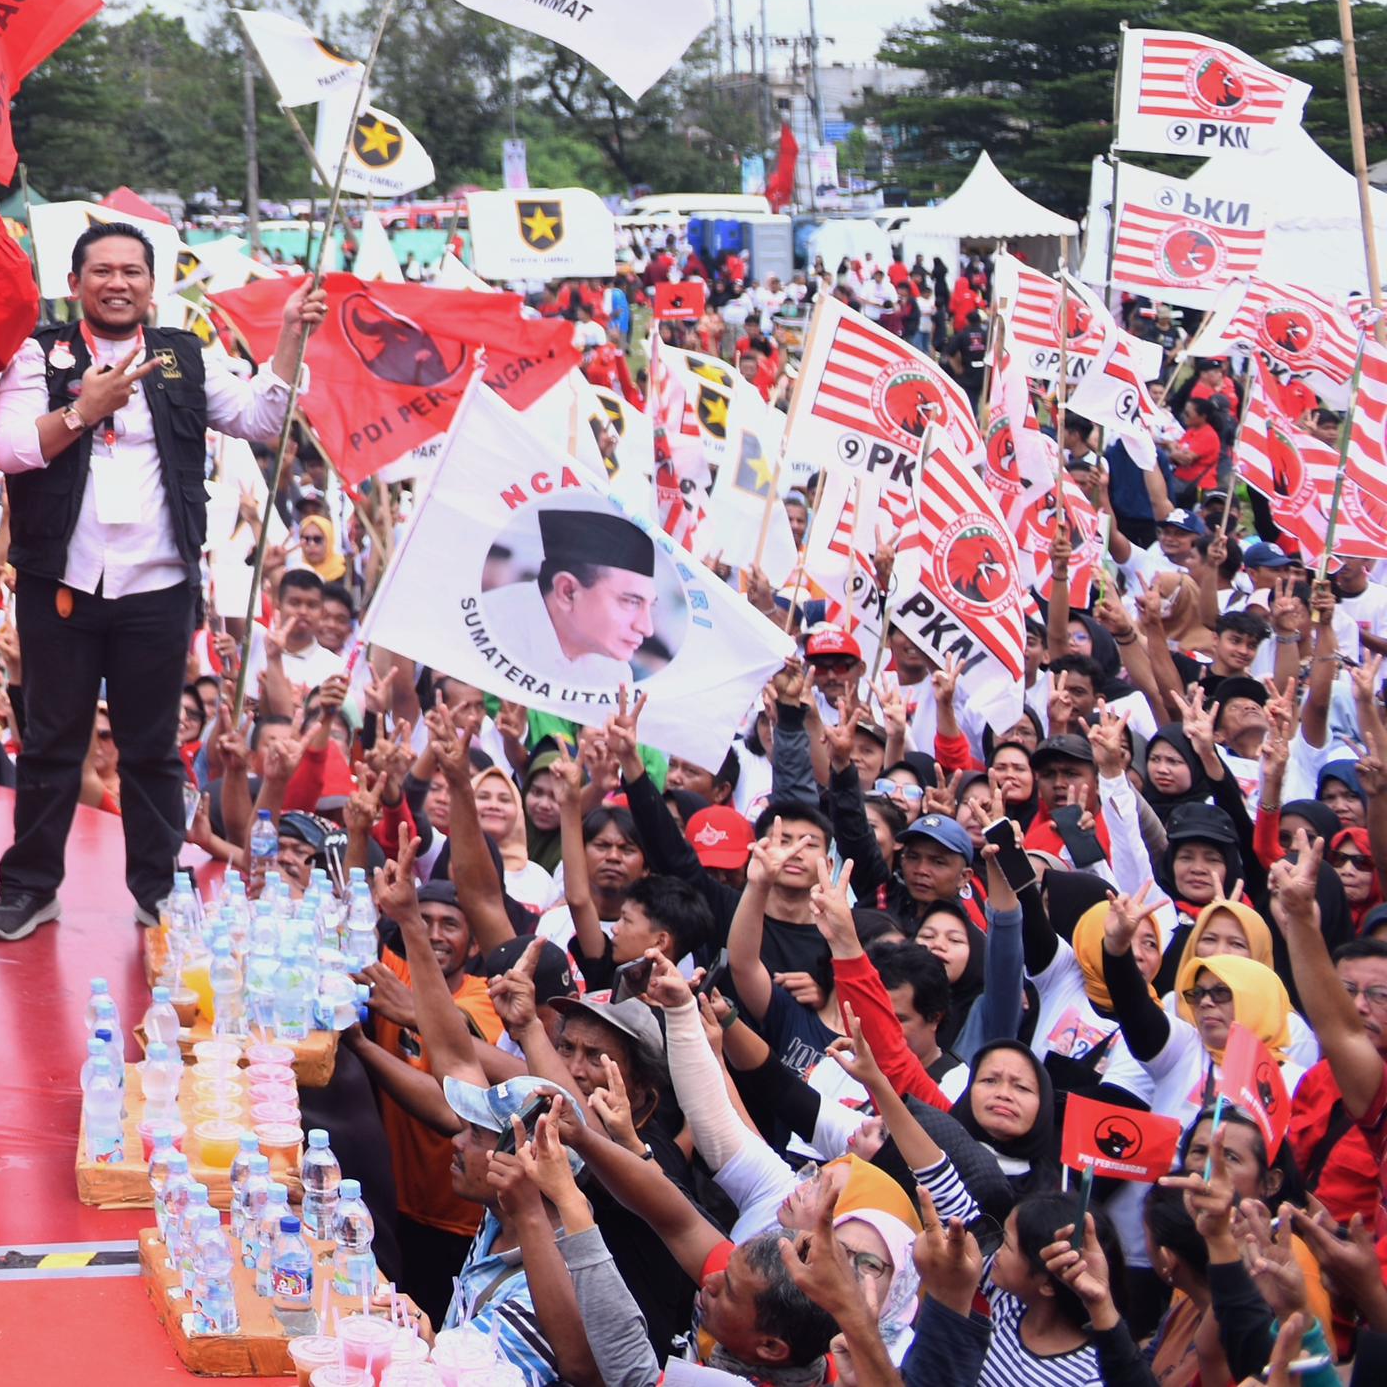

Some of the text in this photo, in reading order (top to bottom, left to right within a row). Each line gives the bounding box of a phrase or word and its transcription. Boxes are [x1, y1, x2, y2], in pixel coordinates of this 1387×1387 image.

[1173, 123, 1251, 149] 9 PKN
[1034, 352, 1046, 367] 9
[350, 415, 393, 451] PDI
[844, 439, 917, 487] 9 PK
[460, 597, 553, 699] SUMATERA
[896, 591, 989, 676] PKN
